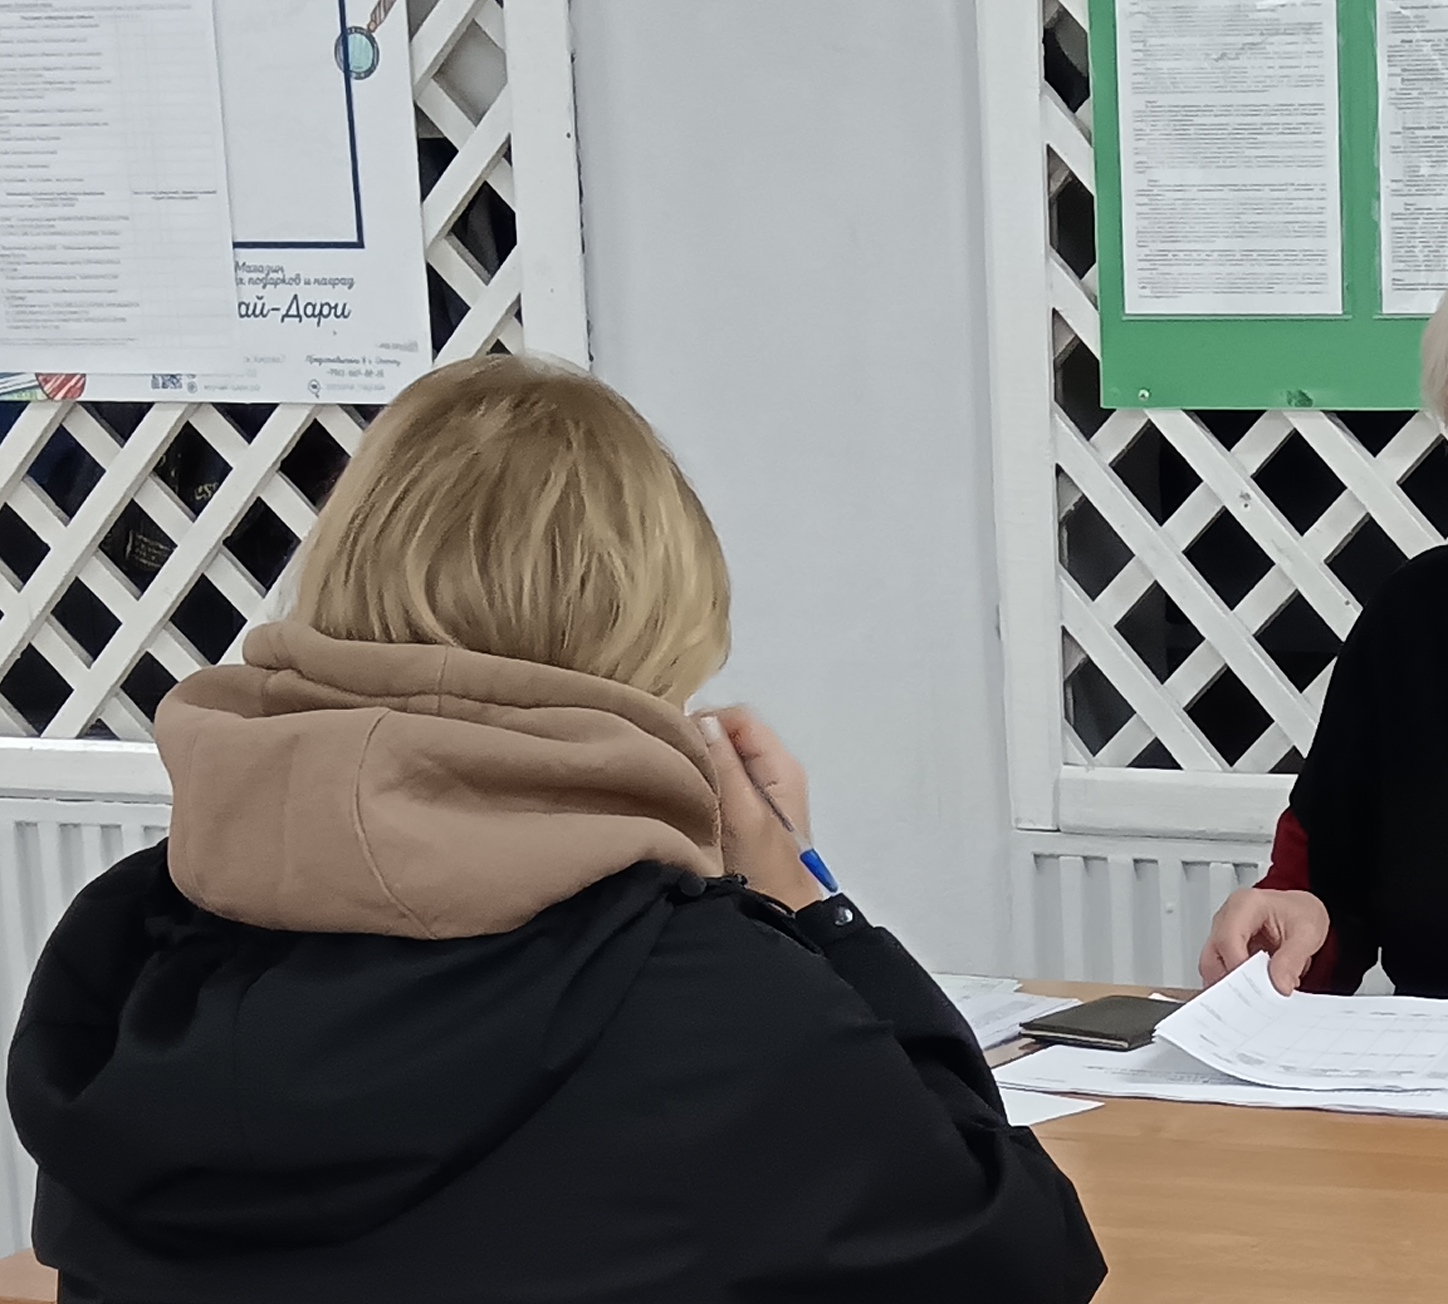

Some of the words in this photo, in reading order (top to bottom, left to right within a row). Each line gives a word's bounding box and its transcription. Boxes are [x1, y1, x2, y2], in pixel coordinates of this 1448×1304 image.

[235, 261, 285, 277] Магазин
[248, 273, 302, 290] подарков
[303, 278, 312, 287] и
[314, 277, 355, 290] наград
[238, 293, 352, 328] ай-Дари
